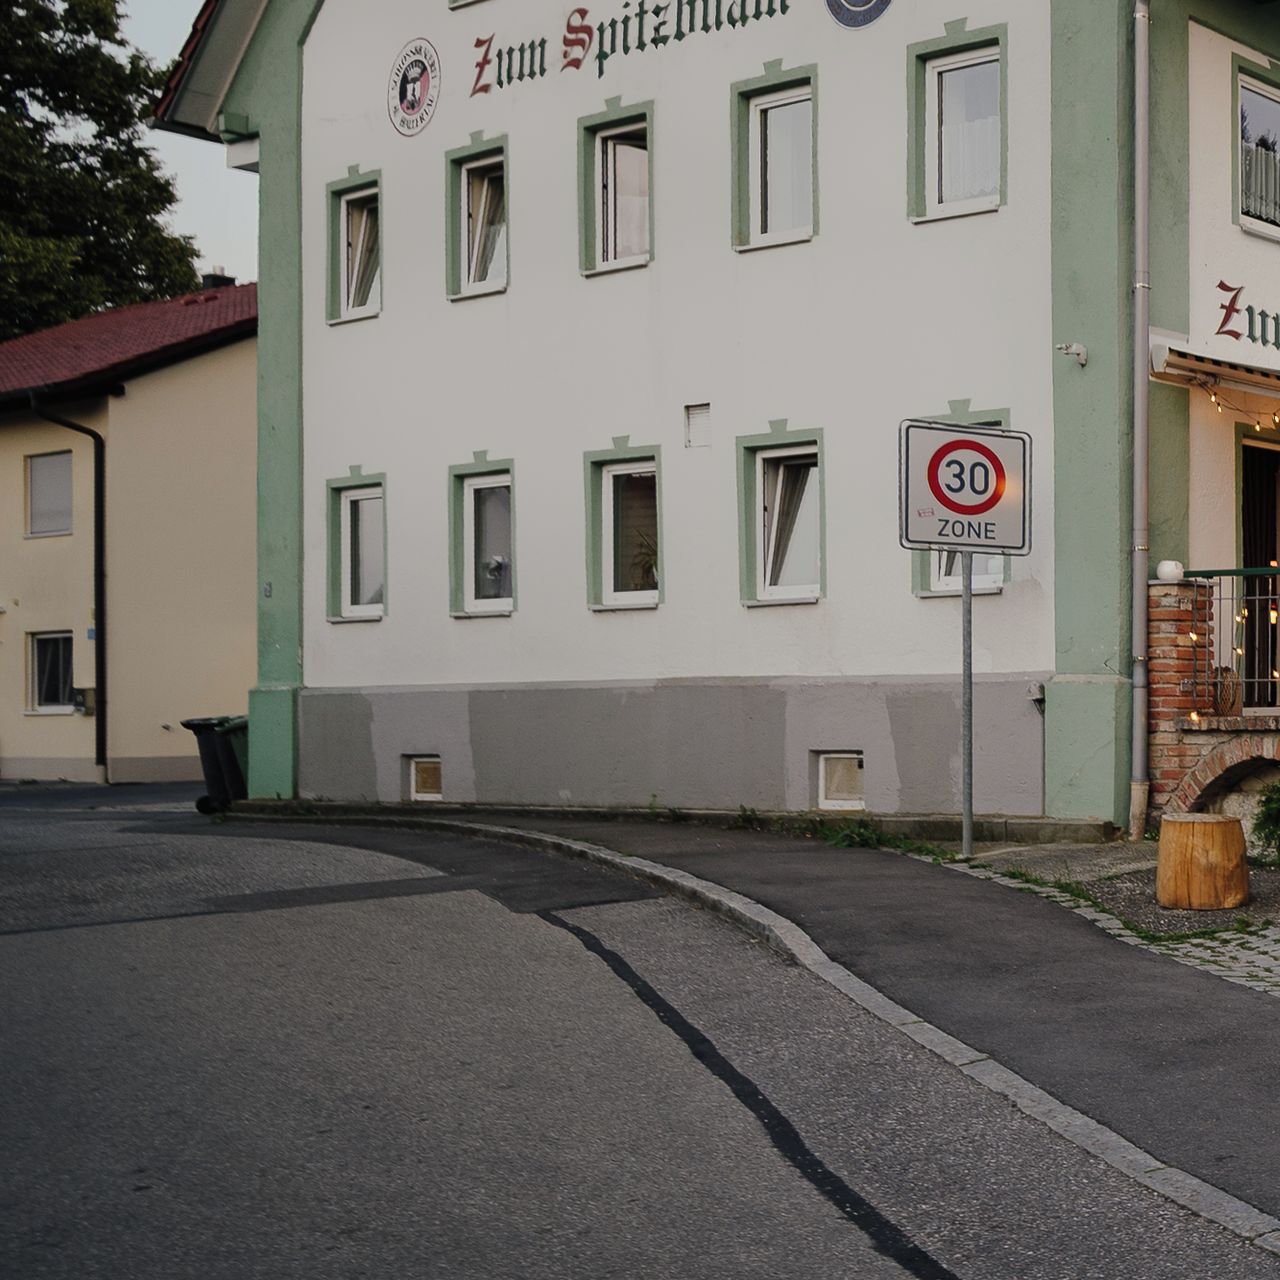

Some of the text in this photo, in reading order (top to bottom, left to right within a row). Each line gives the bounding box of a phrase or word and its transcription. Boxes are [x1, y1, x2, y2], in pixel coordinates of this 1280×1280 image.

[469, 32, 547, 98] Zum
[945, 459, 990, 495] 30
[938, 518, 997, 540] ZONE
